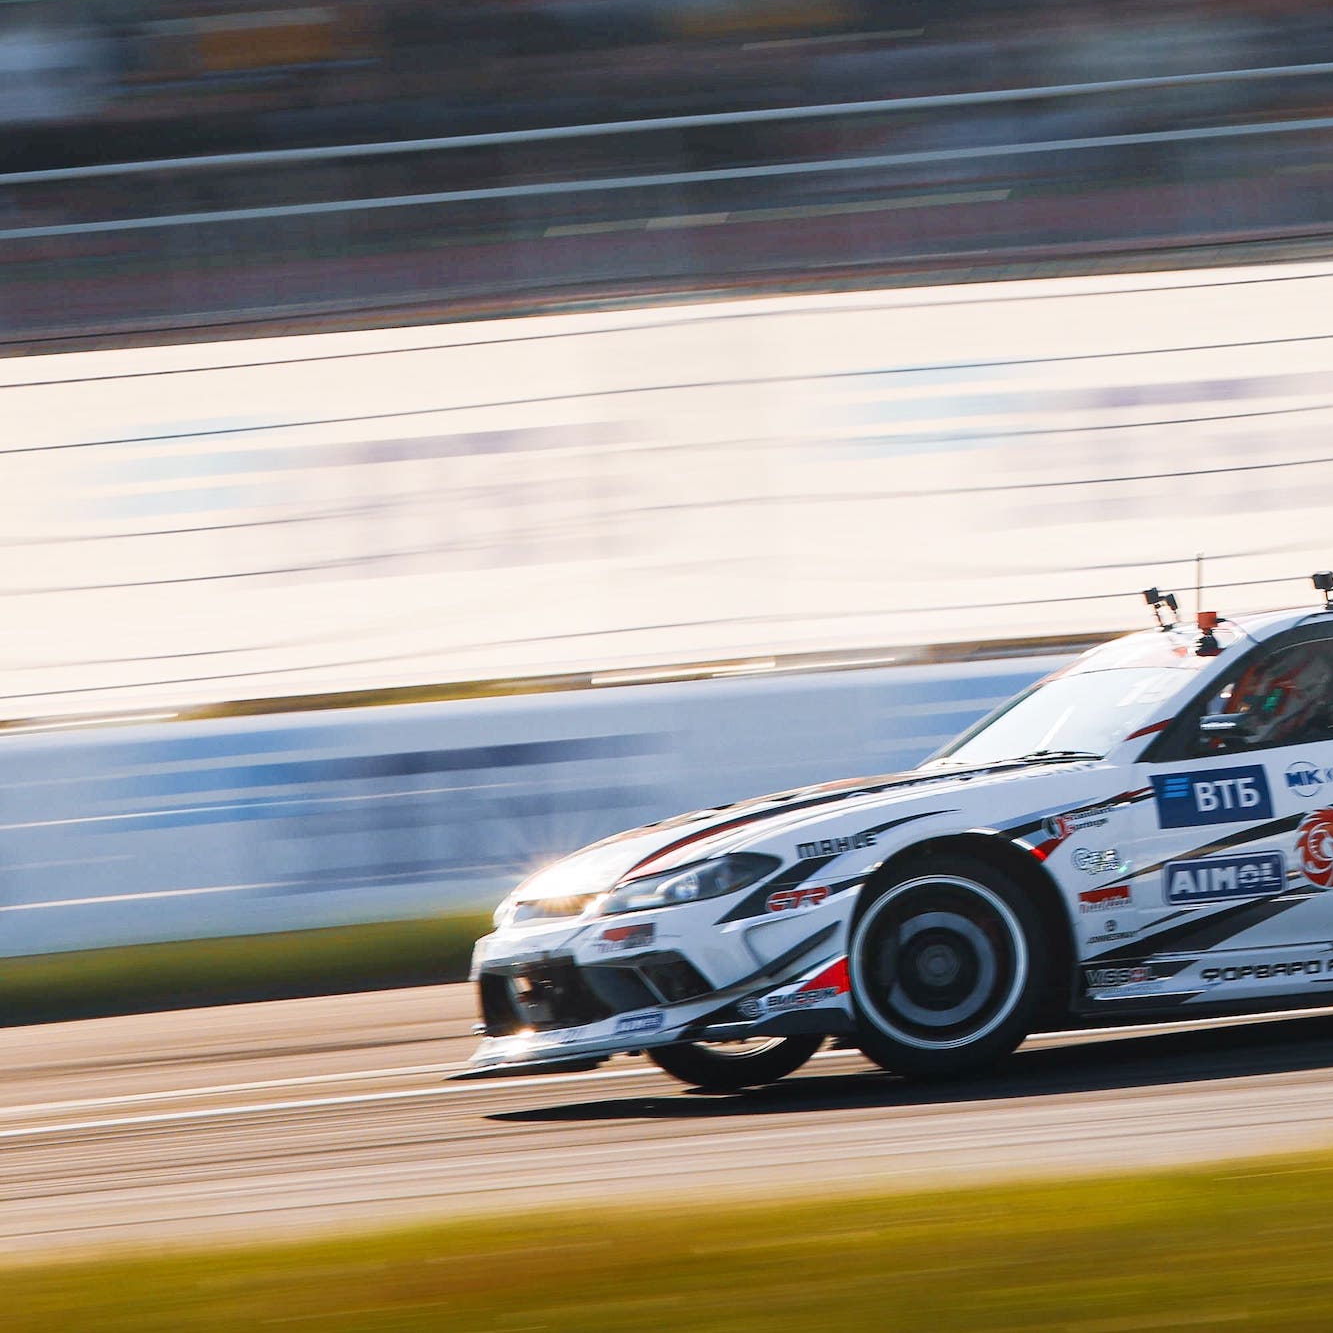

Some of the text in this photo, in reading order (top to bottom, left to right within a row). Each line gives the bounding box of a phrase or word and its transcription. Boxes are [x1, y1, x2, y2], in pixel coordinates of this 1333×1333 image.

[1193, 776, 1261, 813] ВТБ
[796, 832, 878, 860] MAHLE
[1170, 862, 1281, 896] AIMOL
